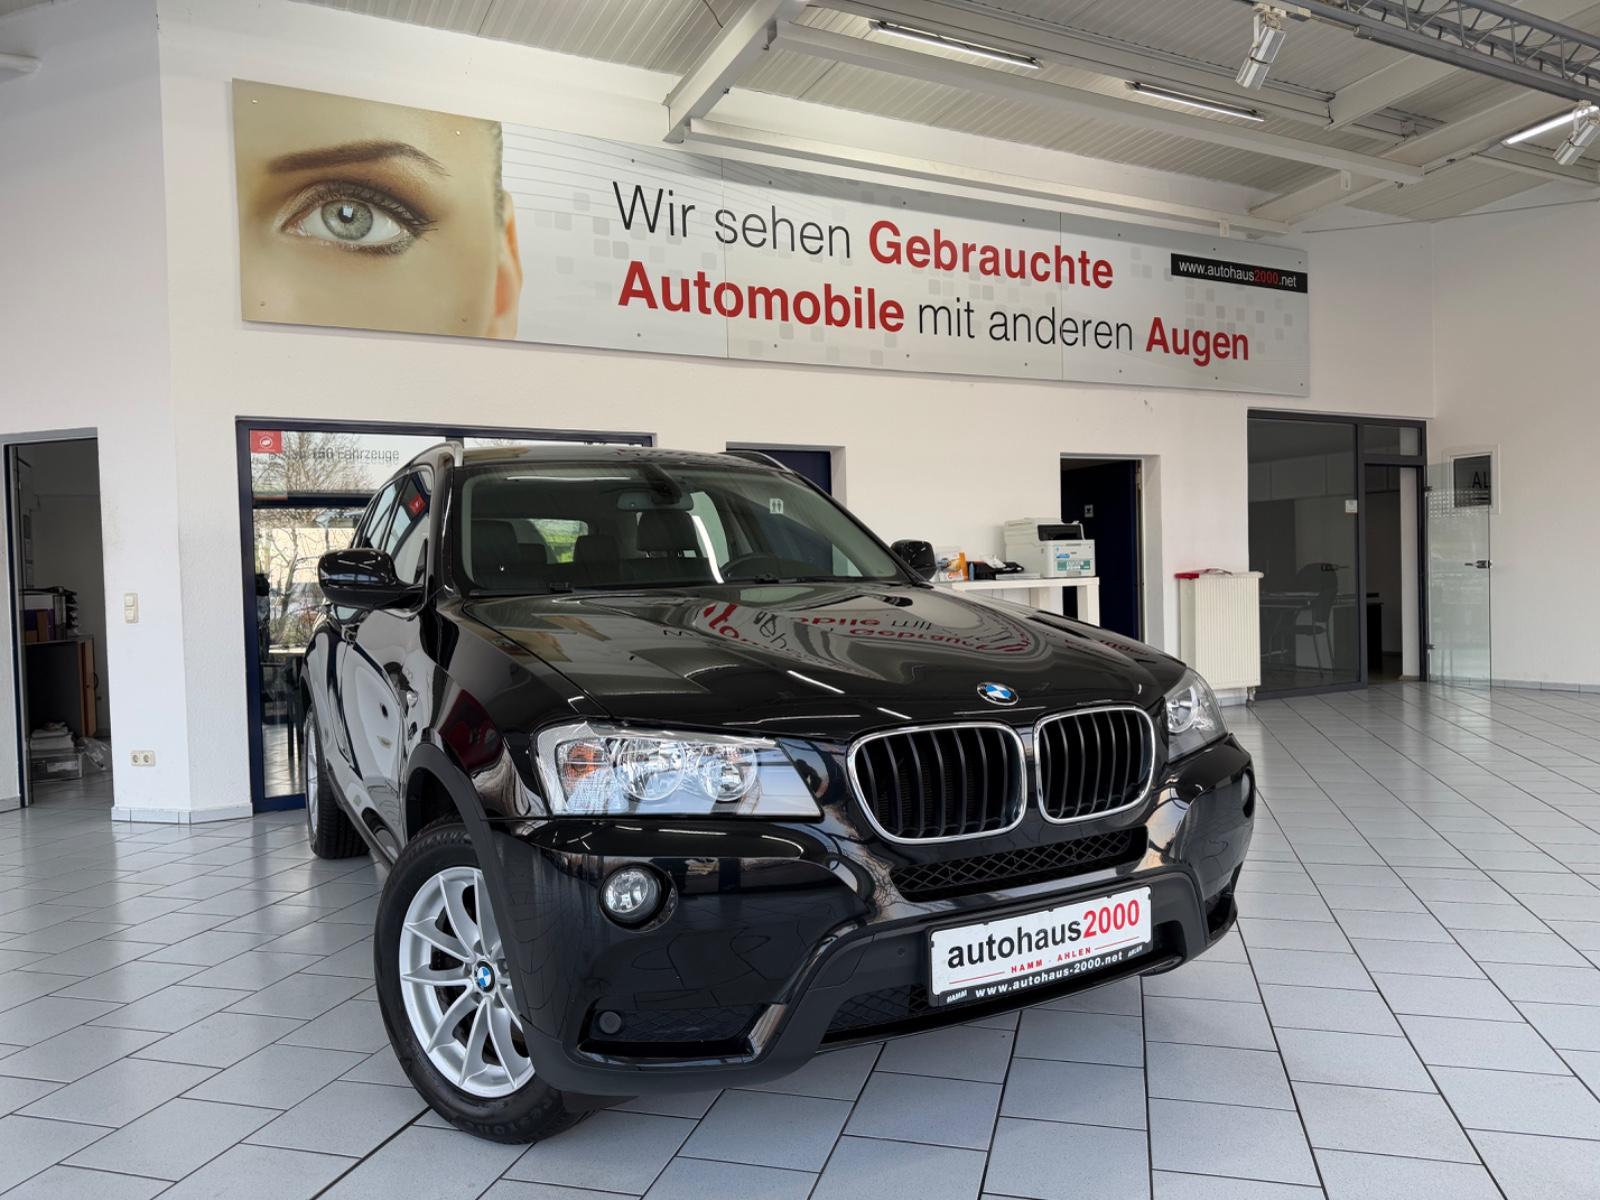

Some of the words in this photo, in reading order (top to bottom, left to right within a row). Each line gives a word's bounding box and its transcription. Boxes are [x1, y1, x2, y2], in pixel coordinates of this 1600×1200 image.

[612, 180, 696, 237] Wir
[714, 205, 851, 259] sehen
[868, 219, 1114, 290] Gebrauchte
[1178, 259, 1298, 288] www.autohaus2000.net
[617, 260, 905, 333] Automobile
[918, 297, 976, 339] mit
[988, 306, 1134, 352] anderen
[1145, 316, 1250, 368] Augen
[338, 447, 400, 462] Fahrzeuge
[947, 898, 1140, 969] autohaus2000
[975, 951, 1123, 998] www.autohaus-2000.net
[1011, 959, 1043, 974] HAMM
[1057, 947, 1092, 962] AHLEN
